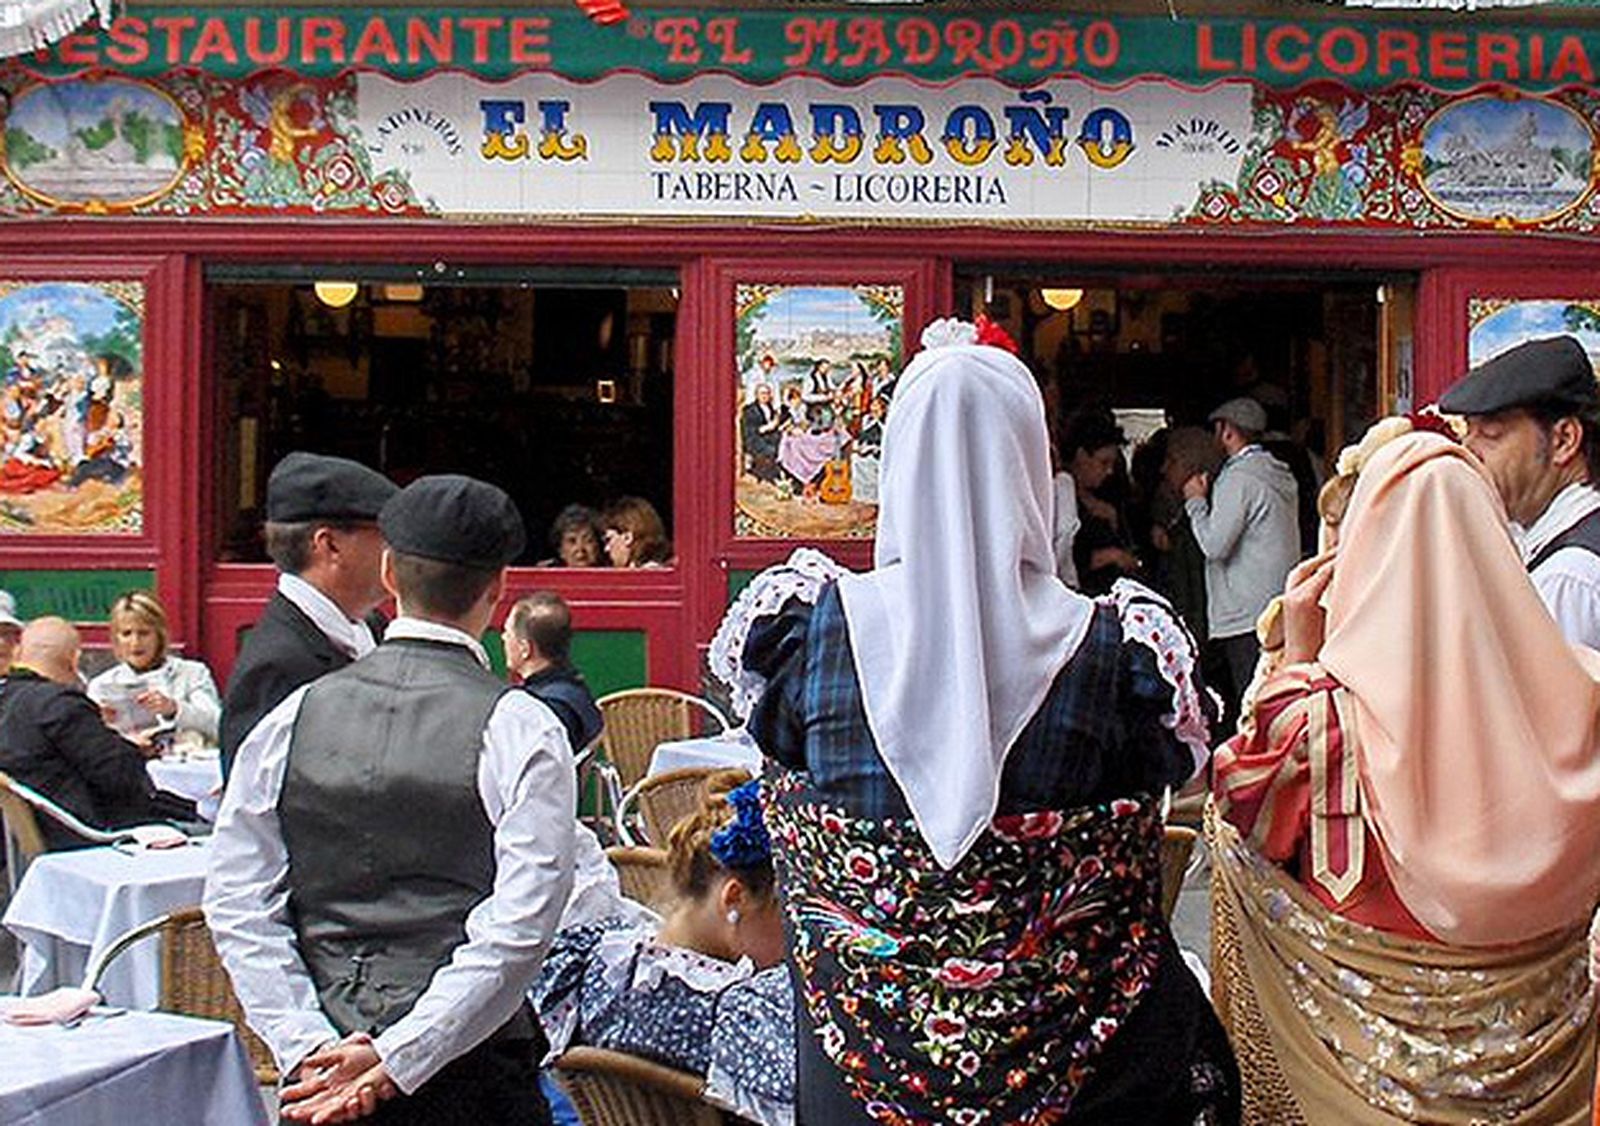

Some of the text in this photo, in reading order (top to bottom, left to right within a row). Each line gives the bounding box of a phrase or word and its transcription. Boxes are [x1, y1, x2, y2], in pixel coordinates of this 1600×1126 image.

[36, 16, 552, 64] ESTAURANTE
[654, 17, 1120, 68] EL MADROÑO
[1196, 23, 1595, 82] LICORERIA
[479, 91, 1136, 168] EL MADROÑO
[1156, 119, 1240, 154] MADRID
[651, 172, 798, 201] TABERNA
[834, 173, 1007, 204] LICORERIA
